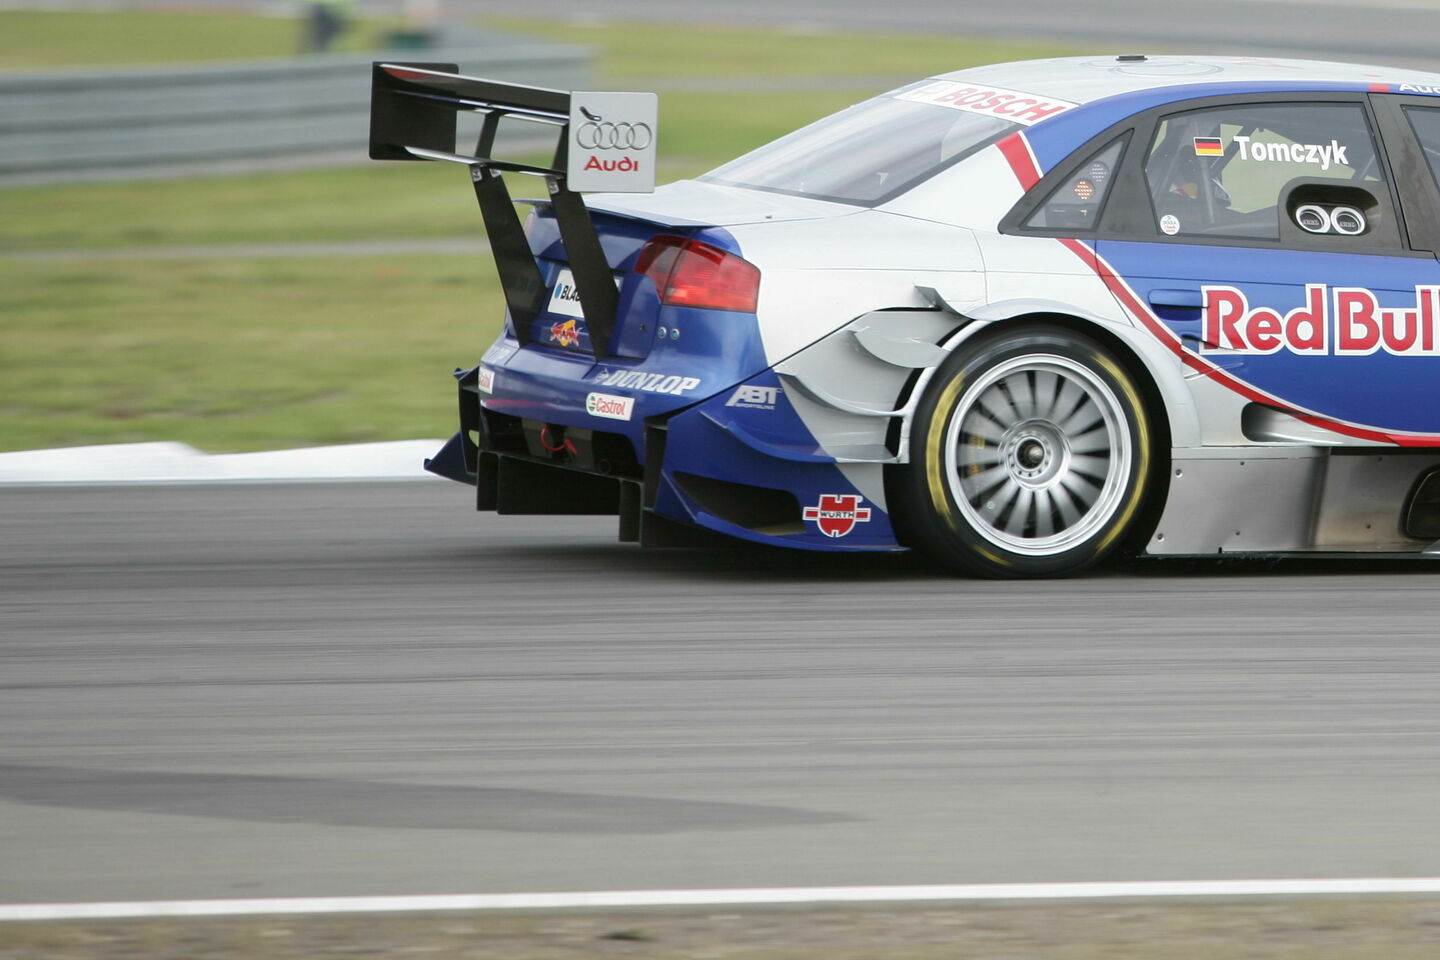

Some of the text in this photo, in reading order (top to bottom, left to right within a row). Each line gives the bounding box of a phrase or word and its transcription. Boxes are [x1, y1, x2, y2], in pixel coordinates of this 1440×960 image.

[933, 87, 1067, 121] BOSCH
[583, 156, 639, 171] Audi
[1233, 135, 1349, 171] Tomczyk
[1202, 285, 1328, 356] Red
[603, 369, 702, 395] DUNLOP
[595, 396, 627, 416] Castrol
[725, 385, 777, 406] ABT
